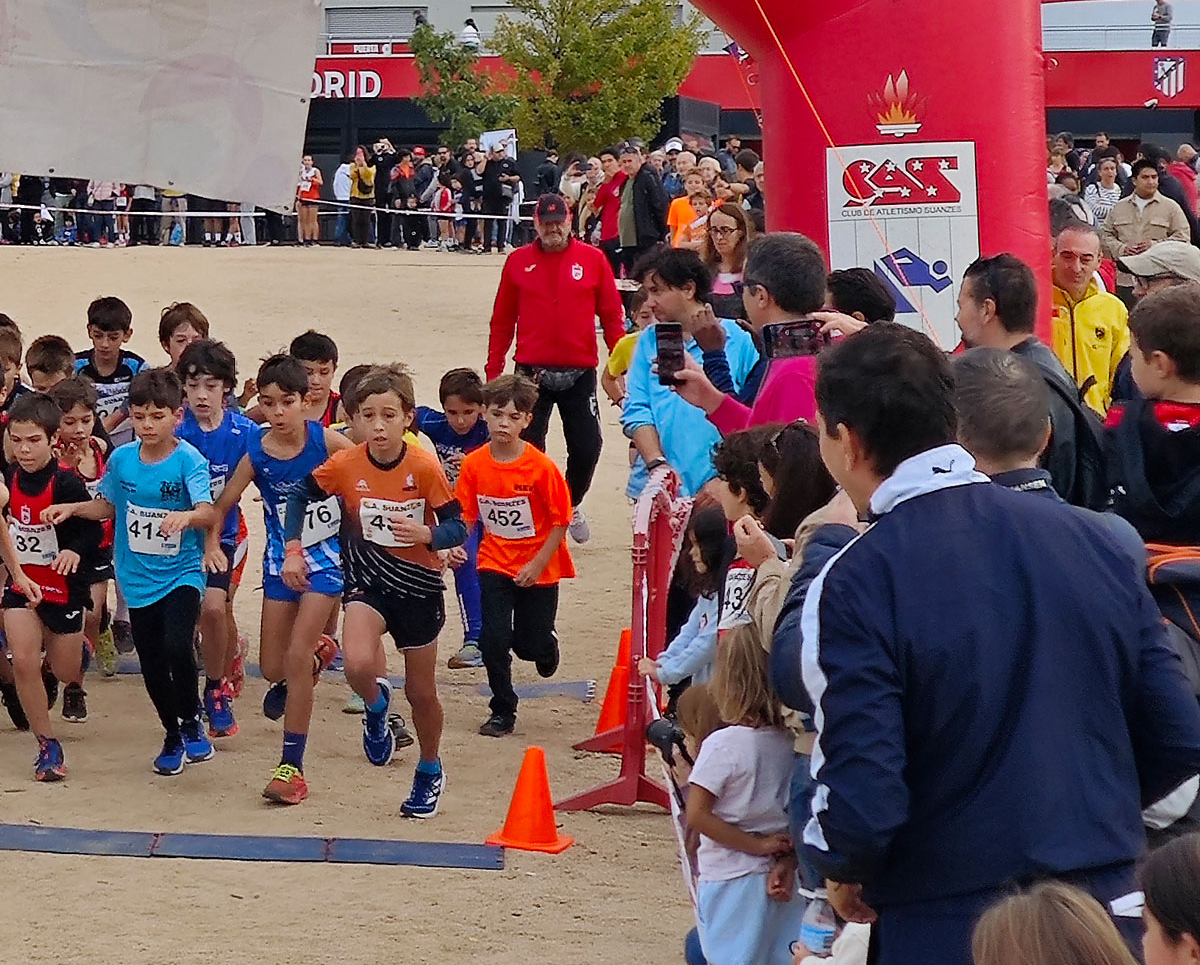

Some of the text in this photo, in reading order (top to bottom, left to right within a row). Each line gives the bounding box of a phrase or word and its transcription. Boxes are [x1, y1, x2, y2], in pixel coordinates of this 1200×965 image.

[311, 70, 381, 98] DRID
[841, 206, 962, 217] CLUB DE ATLETISMO SUANZES
[139, 510, 168, 519] SUANZ
[305, 504, 332, 530] 76
[487, 508, 524, 527] 452
[16, 534, 42, 553] 32
